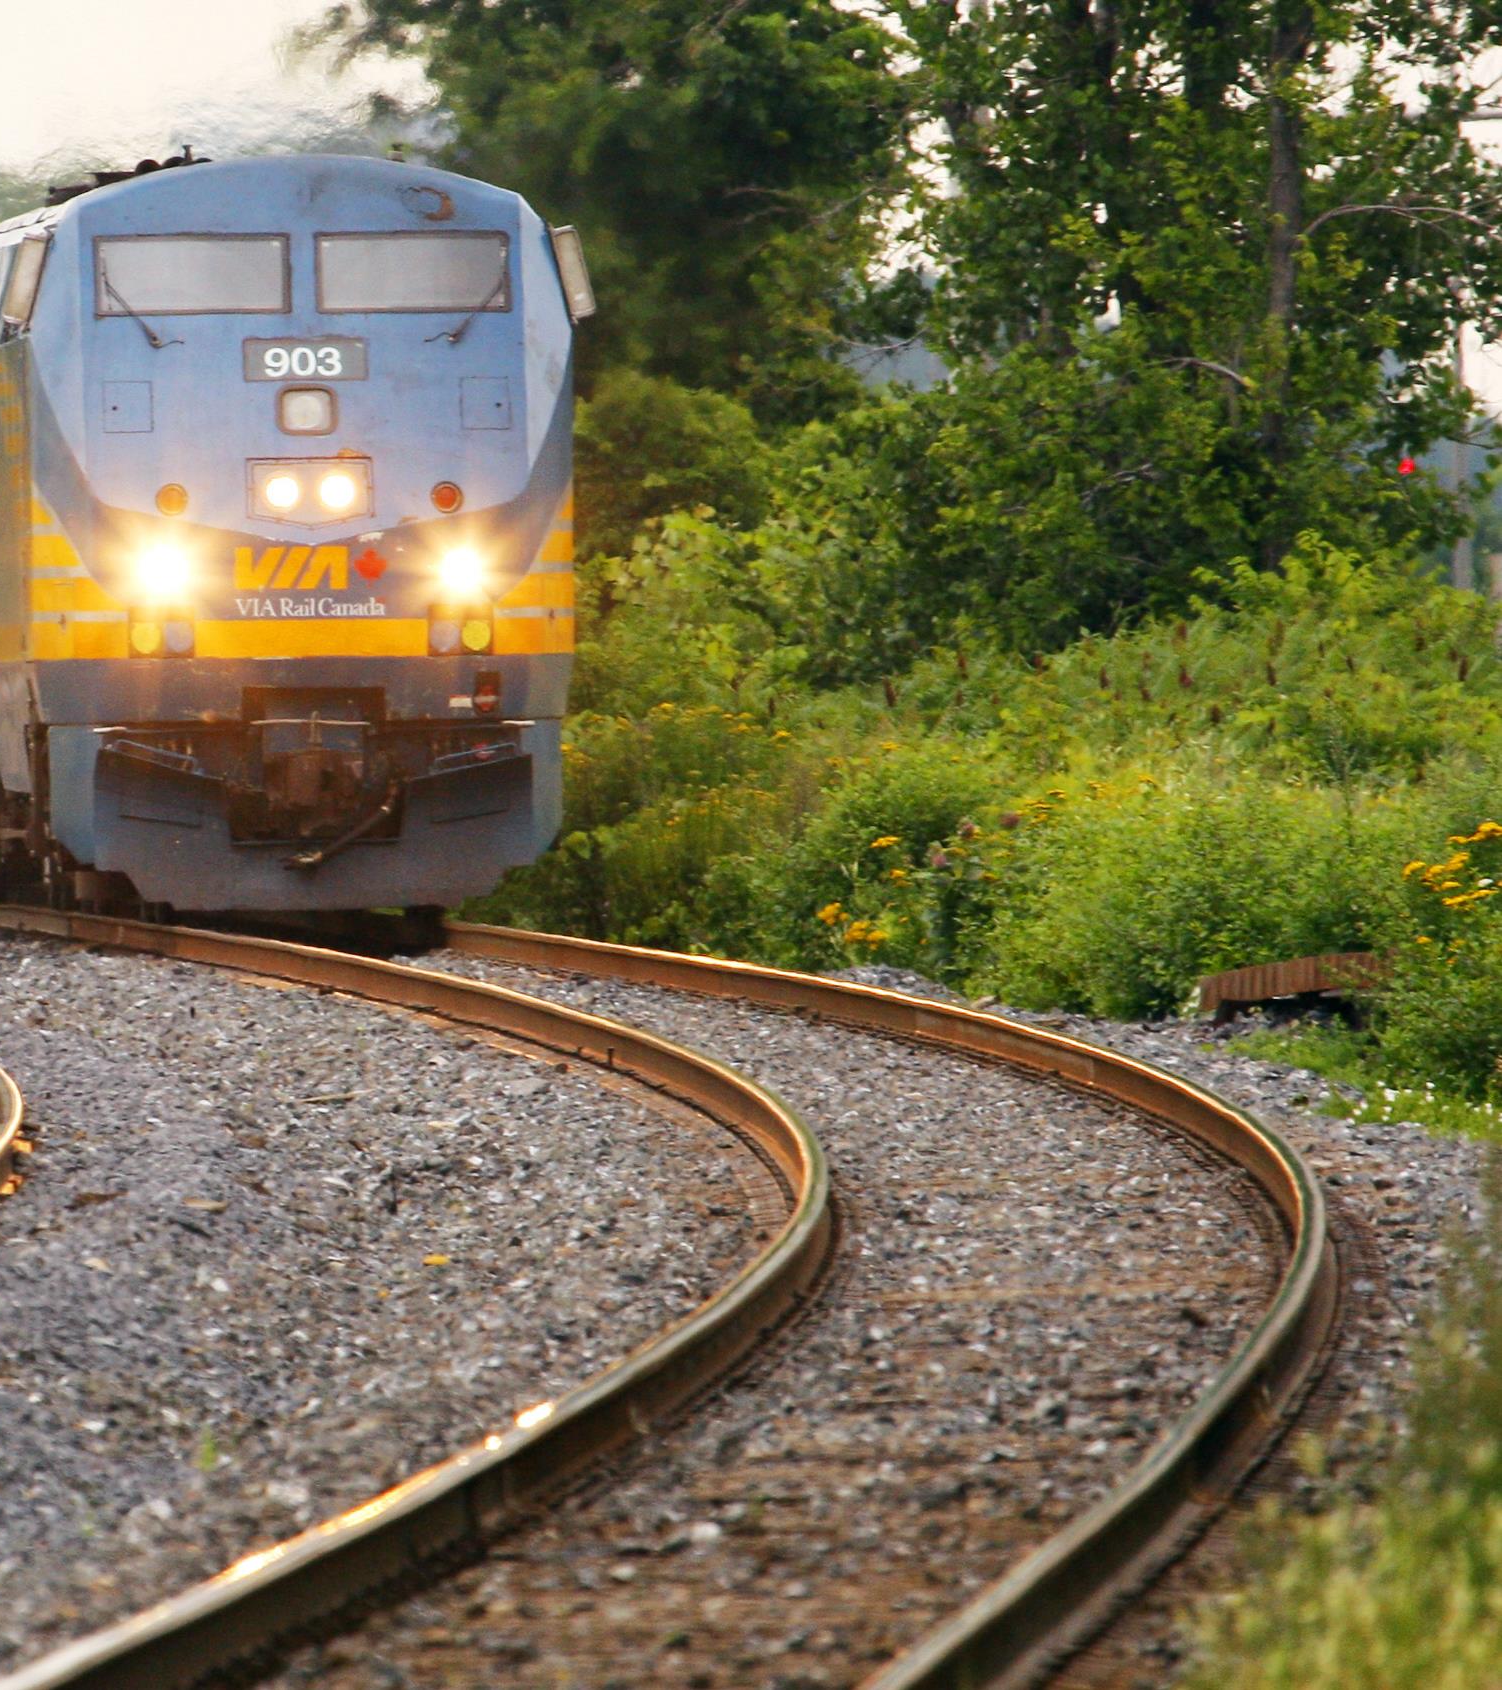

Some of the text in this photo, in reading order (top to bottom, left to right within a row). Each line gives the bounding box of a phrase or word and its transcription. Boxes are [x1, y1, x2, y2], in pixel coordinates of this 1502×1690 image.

[264, 347, 343, 377] 903
[234, 545, 348, 590] VIA
[235, 597, 385, 617] VIA Rail Canada
